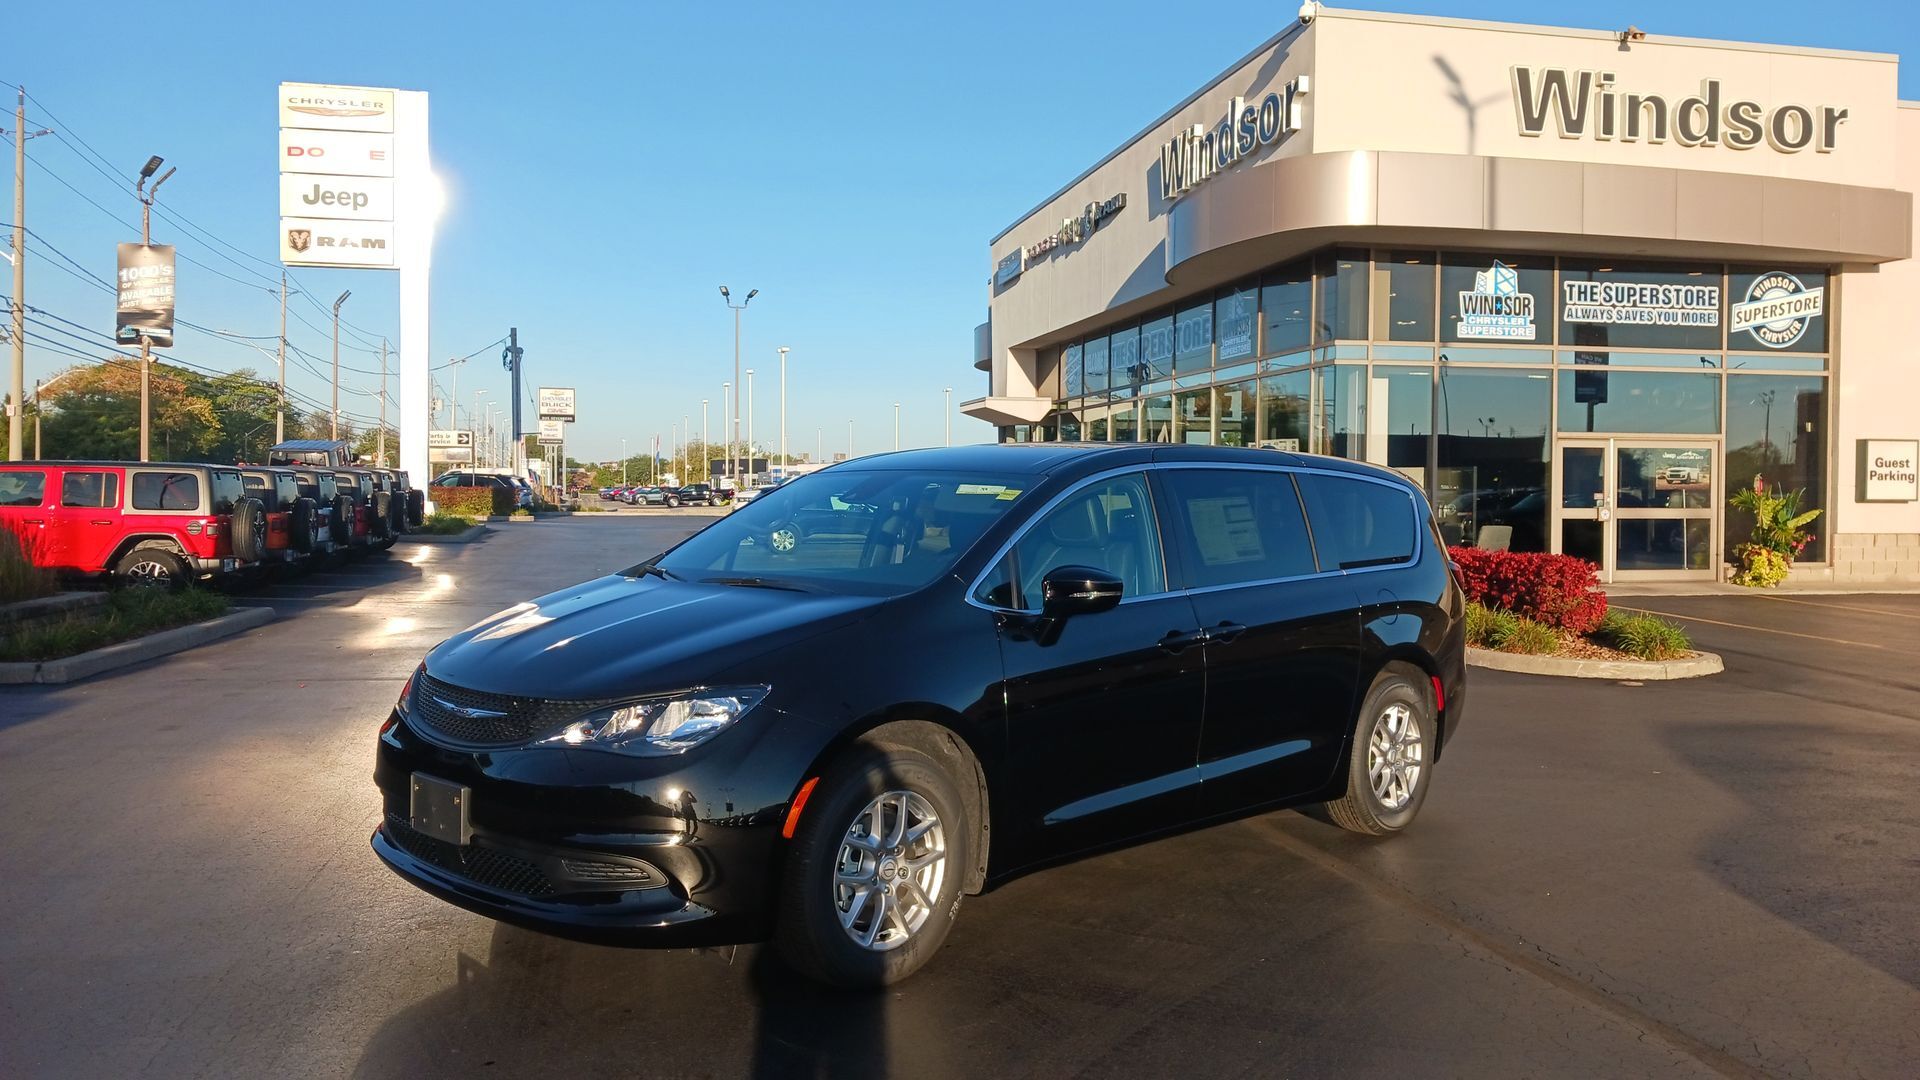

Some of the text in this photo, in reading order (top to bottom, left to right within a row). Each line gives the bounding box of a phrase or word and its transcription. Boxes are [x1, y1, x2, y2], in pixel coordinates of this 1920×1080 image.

[288, 97, 384, 109] CHRYSLER
[1510, 65, 1849, 153] Windsor
[1160, 76, 1308, 200] Windsor
[287, 146, 385, 161] DOE
[302, 184, 369, 211] Jeep
[317, 236, 385, 249] RAM
[1566, 284, 1718, 307] THE SUPERSTORE
[1752, 277, 1796, 298] WINDSOR
[120, 300, 139, 308] JUST
[1462, 295, 1531, 316] WINDSOR
[1735, 295, 1820, 324] SUPERSTORE
[1468, 316, 1525, 326] CHRYSLER
[1566, 308, 1717, 324] ALWAYS SAVES YOU MORE!
[1460, 326, 1533, 336] SUPERSTORE
[1760, 320, 1803, 343] CHRYSLER
[1875, 457, 1911, 468] Guest
[1870, 470, 1915, 484] Parking
